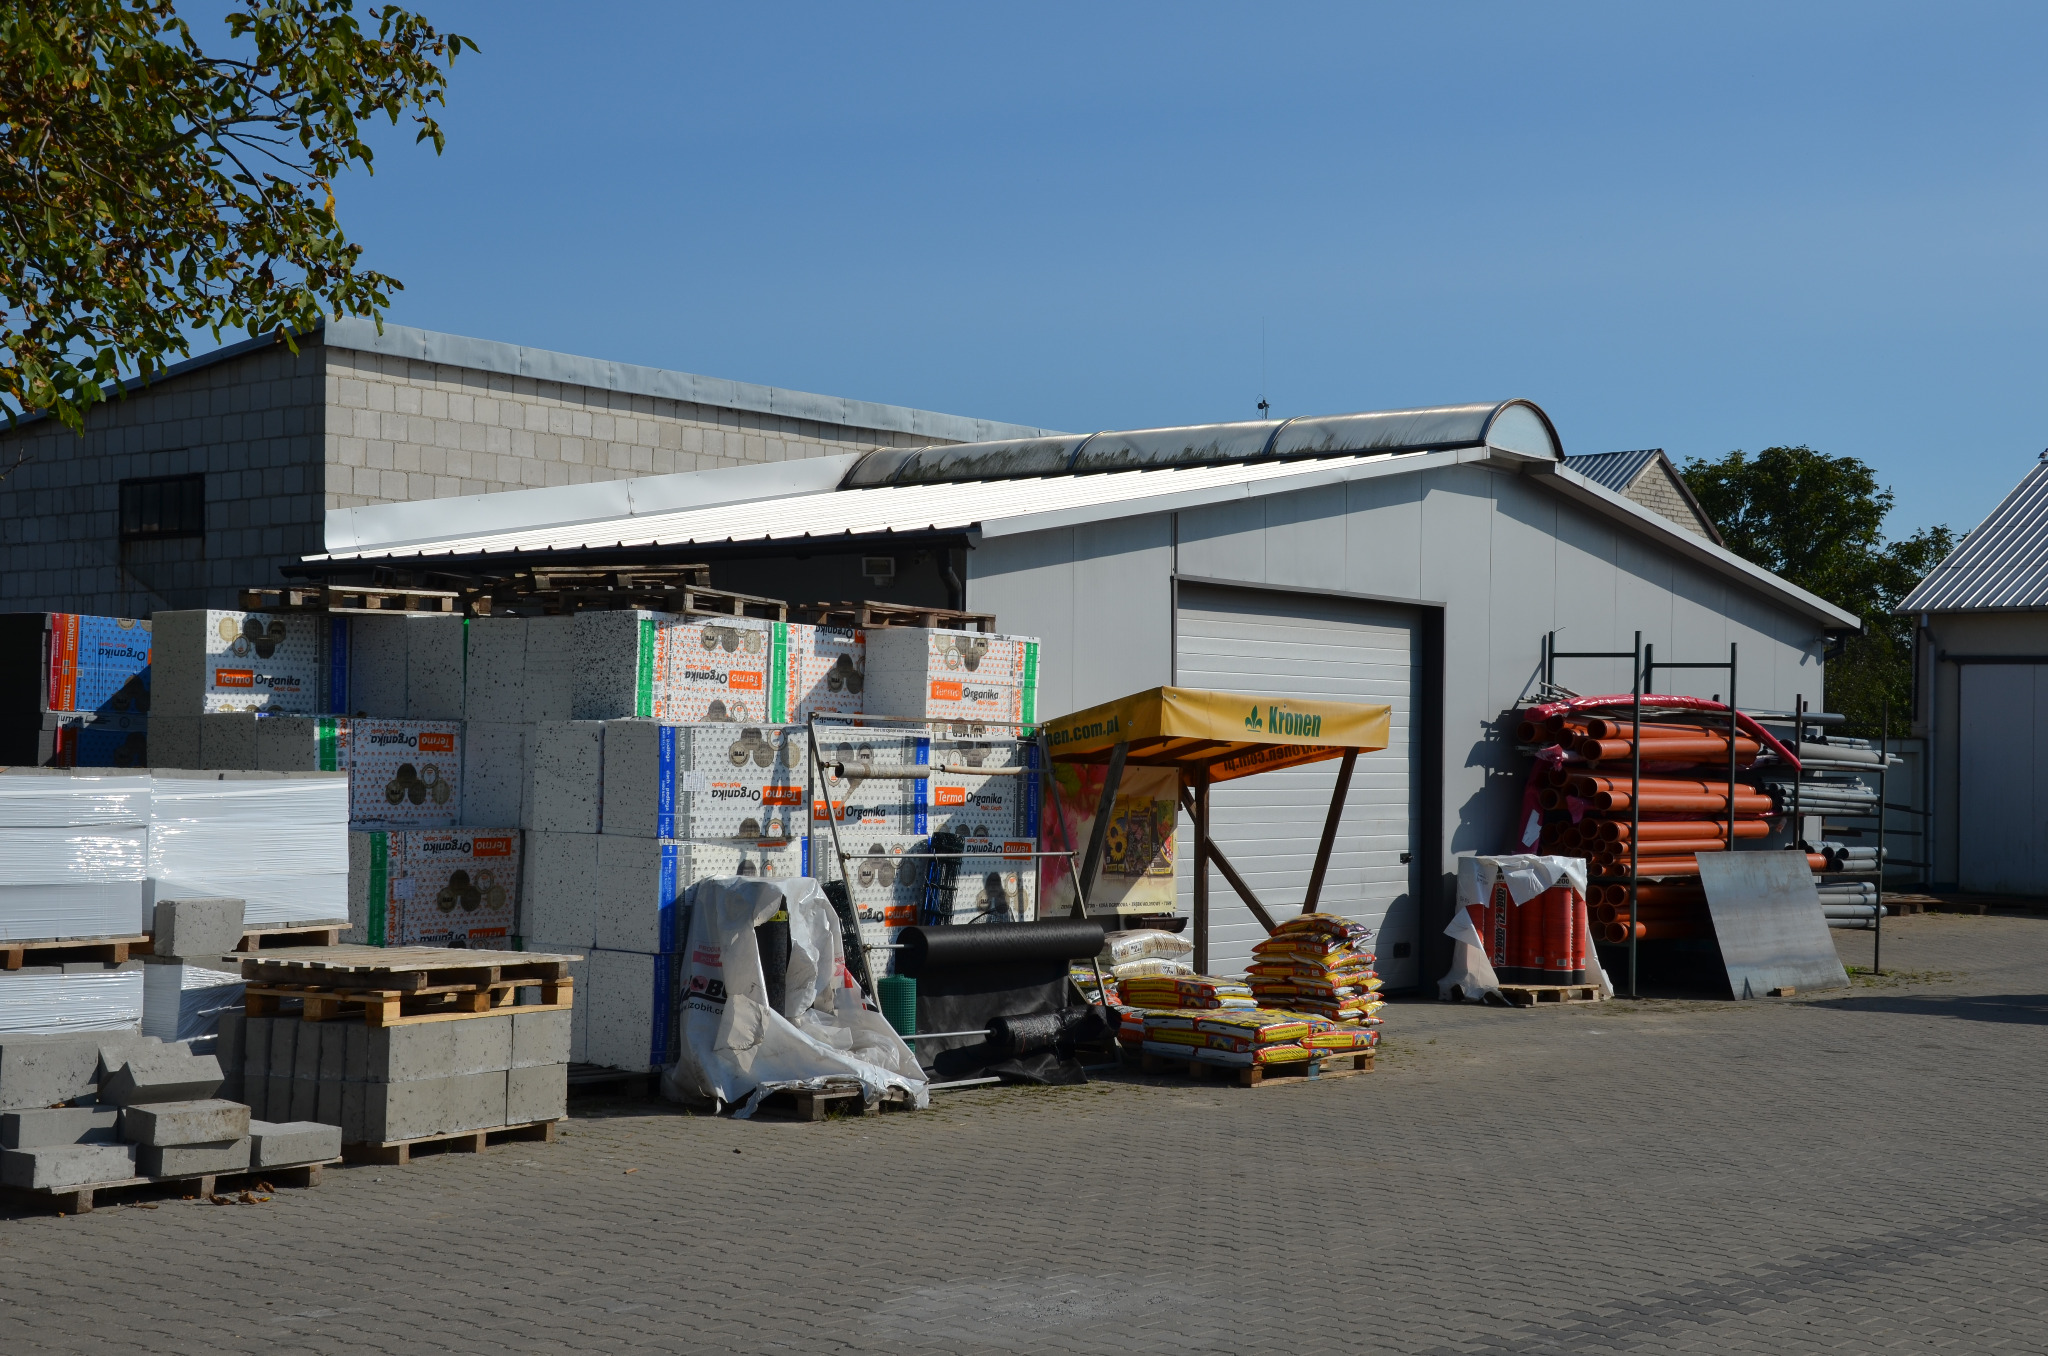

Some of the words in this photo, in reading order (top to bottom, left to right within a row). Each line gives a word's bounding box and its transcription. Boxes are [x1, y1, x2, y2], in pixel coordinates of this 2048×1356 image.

[98, 648, 145, 661] Organika
[219, 673, 251, 684] Termo
[255, 673, 301, 687] Organika
[685, 670, 727, 684] Organika
[731, 674, 759, 686] Termo
[935, 685, 961, 696] Termo
[963, 687, 999, 701] Organika
[1268, 706, 1322, 737] Kronen
[371, 733, 417, 747] Organika
[421, 736, 450, 748] Termo
[711, 786, 761, 801] Organika
[765, 789, 797, 802] Termo
[938, 791, 963, 803] Termo
[966, 792, 1002, 806] Organika
[846, 806, 886, 819] Organika
[423, 839, 471, 854] Organika
[475, 841, 507, 853] Termo
[966, 843, 1002, 853] Organika
[887, 910, 914, 921] Termo
